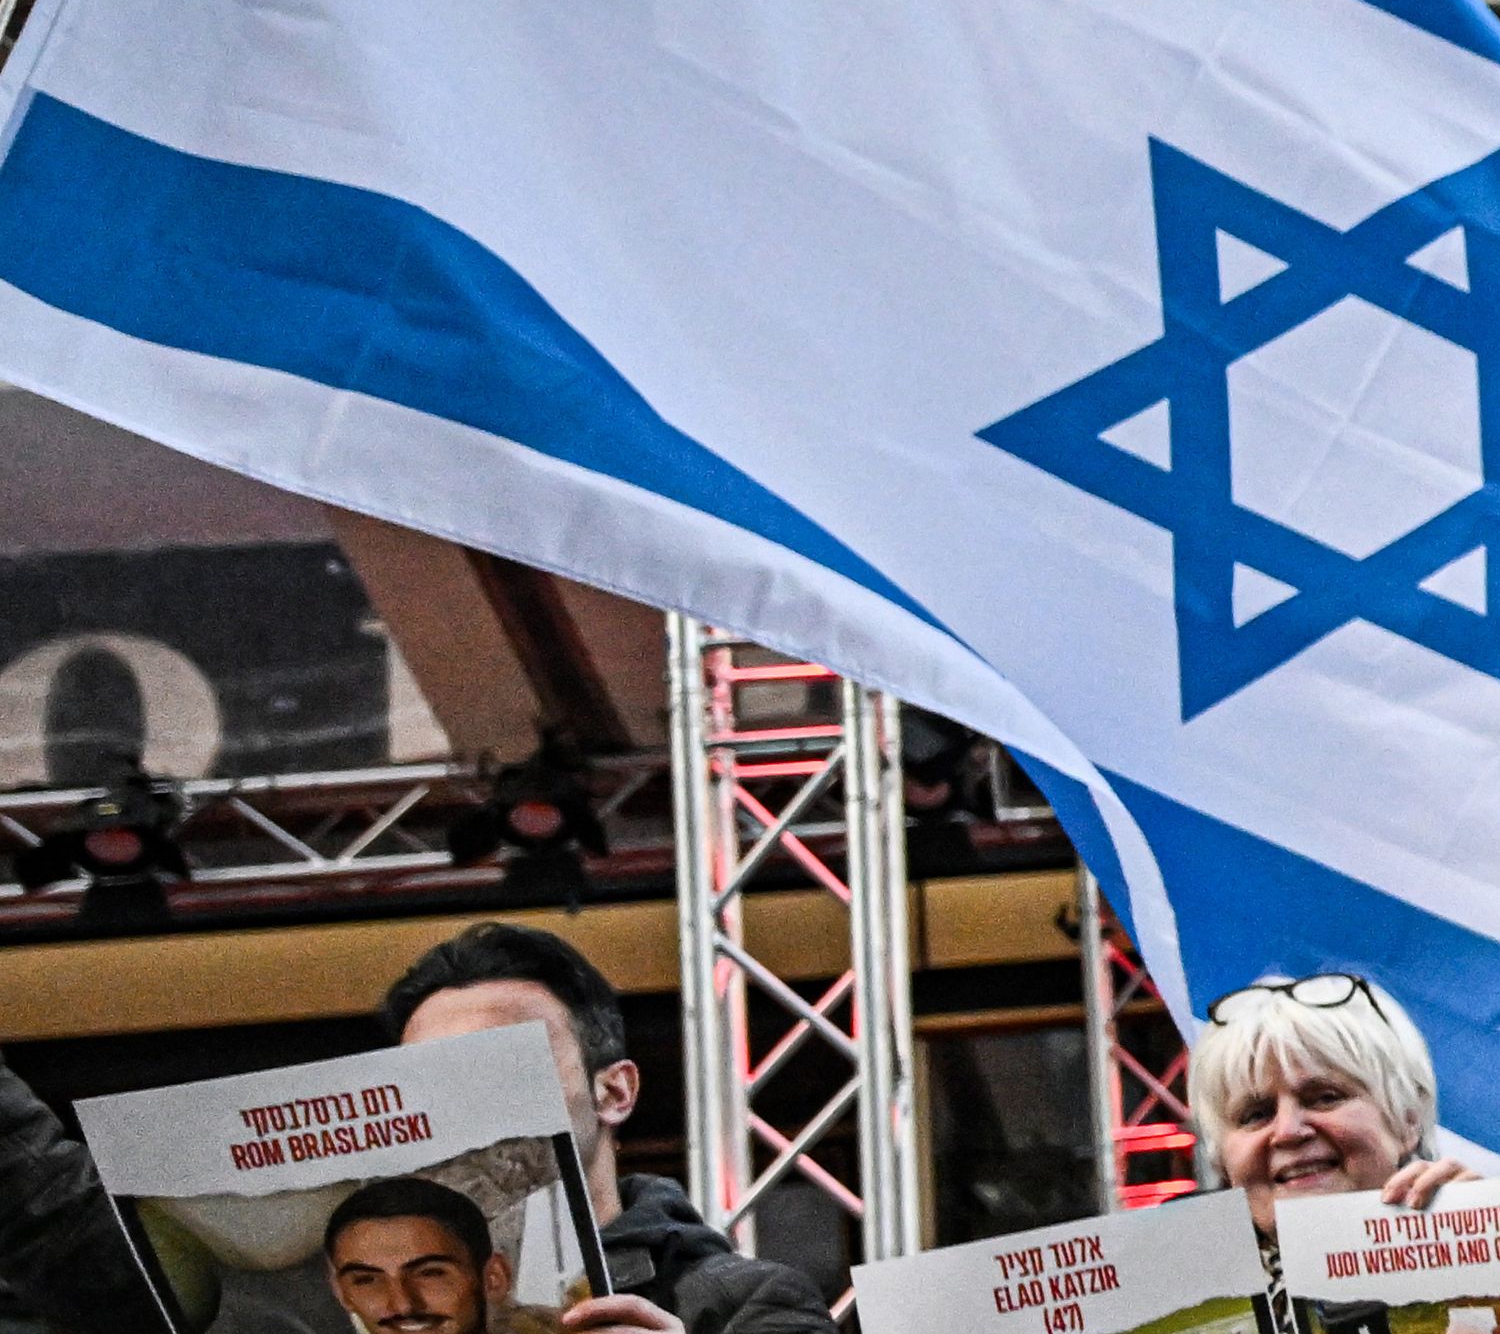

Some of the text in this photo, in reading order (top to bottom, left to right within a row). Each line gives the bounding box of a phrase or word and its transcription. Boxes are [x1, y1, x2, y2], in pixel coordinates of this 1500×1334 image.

[361, 1084, 403, 1116] רום
[230, 1111, 433, 1170] ROM BRASLAVSKI
[1048, 1235, 1104, 1268] אלעד
[1326, 1252, 1360, 1279] JUDI
[1362, 1242, 1453, 1275] WEINSTEIN
[1457, 1239, 1491, 1267] AND
[993, 1264, 1120, 1314] ELAD KATZIR
